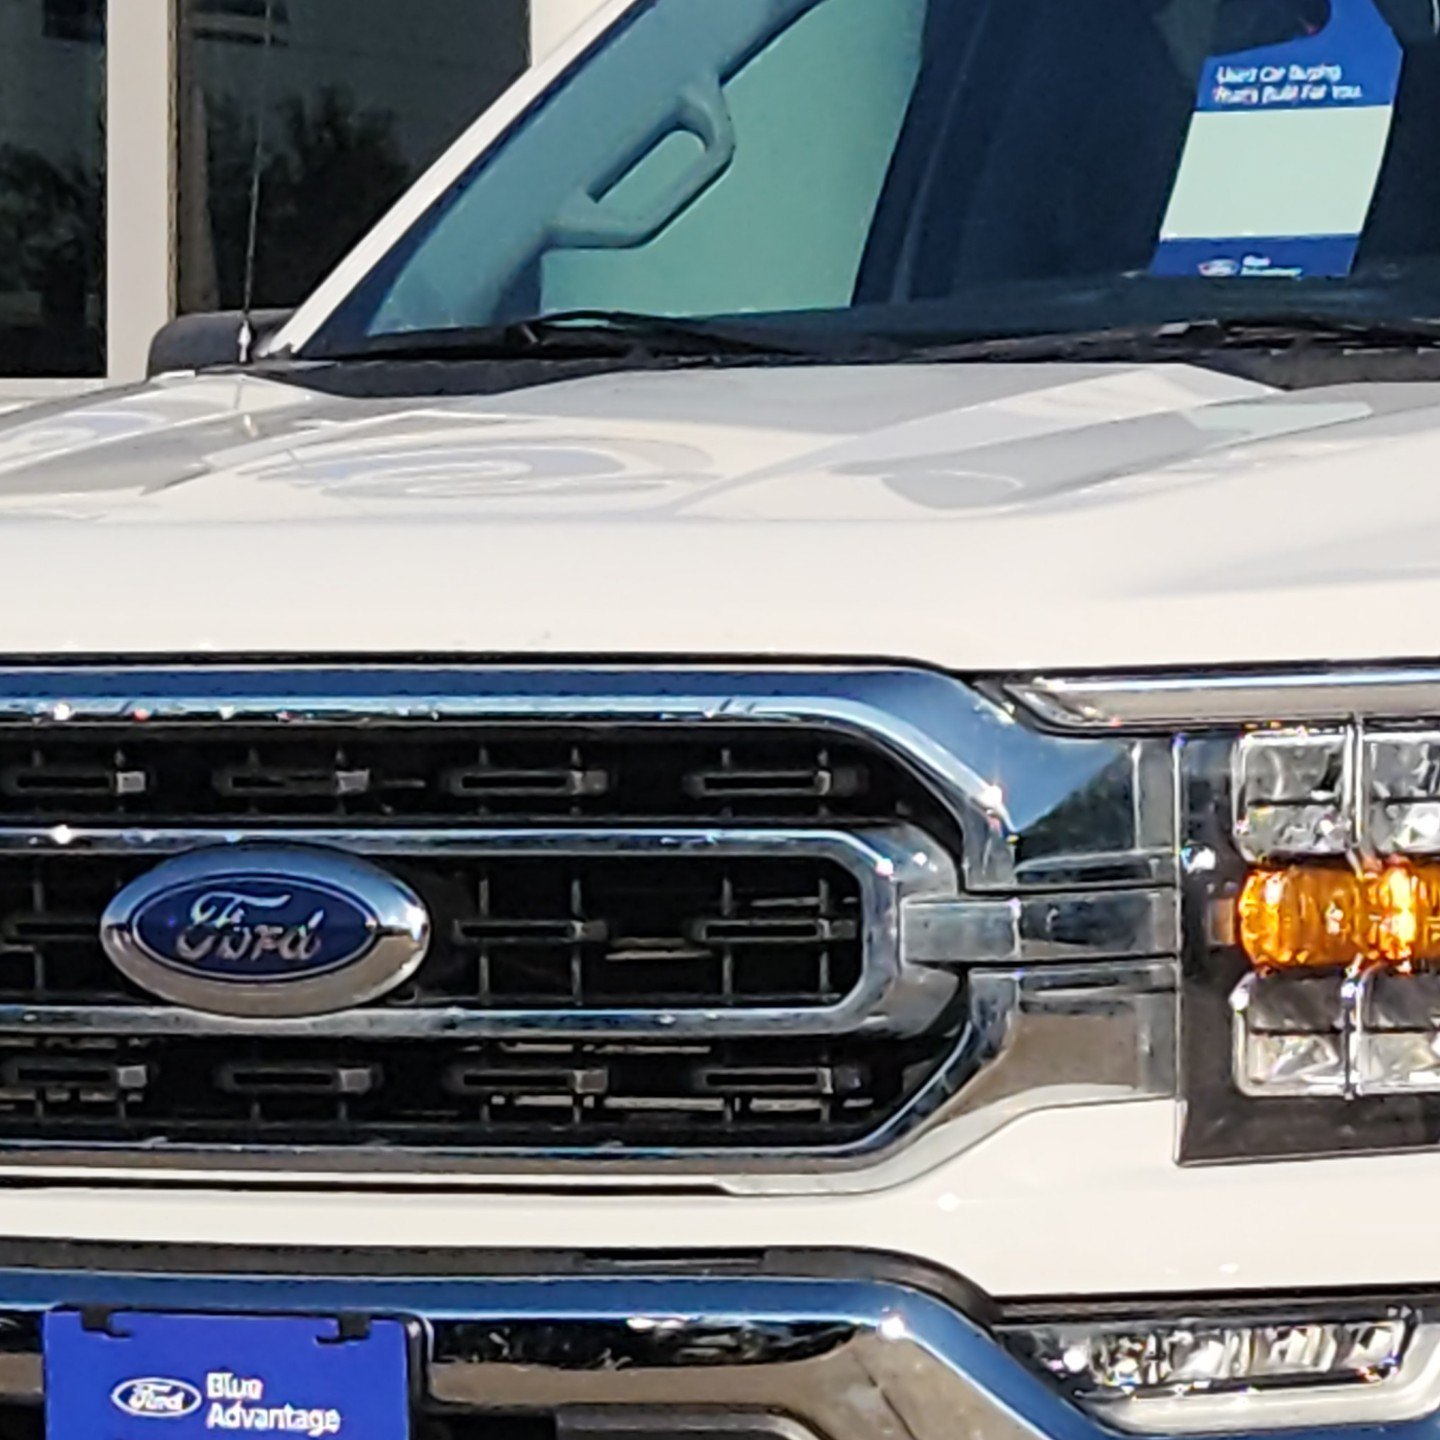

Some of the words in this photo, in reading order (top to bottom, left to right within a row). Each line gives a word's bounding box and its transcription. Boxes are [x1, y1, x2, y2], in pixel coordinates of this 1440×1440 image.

[173, 890, 325, 962] Ford
[127, 1382, 186, 1412] Ford
[205, 1372, 264, 1400] Blue
[205, 1403, 341, 1437] Advantage
